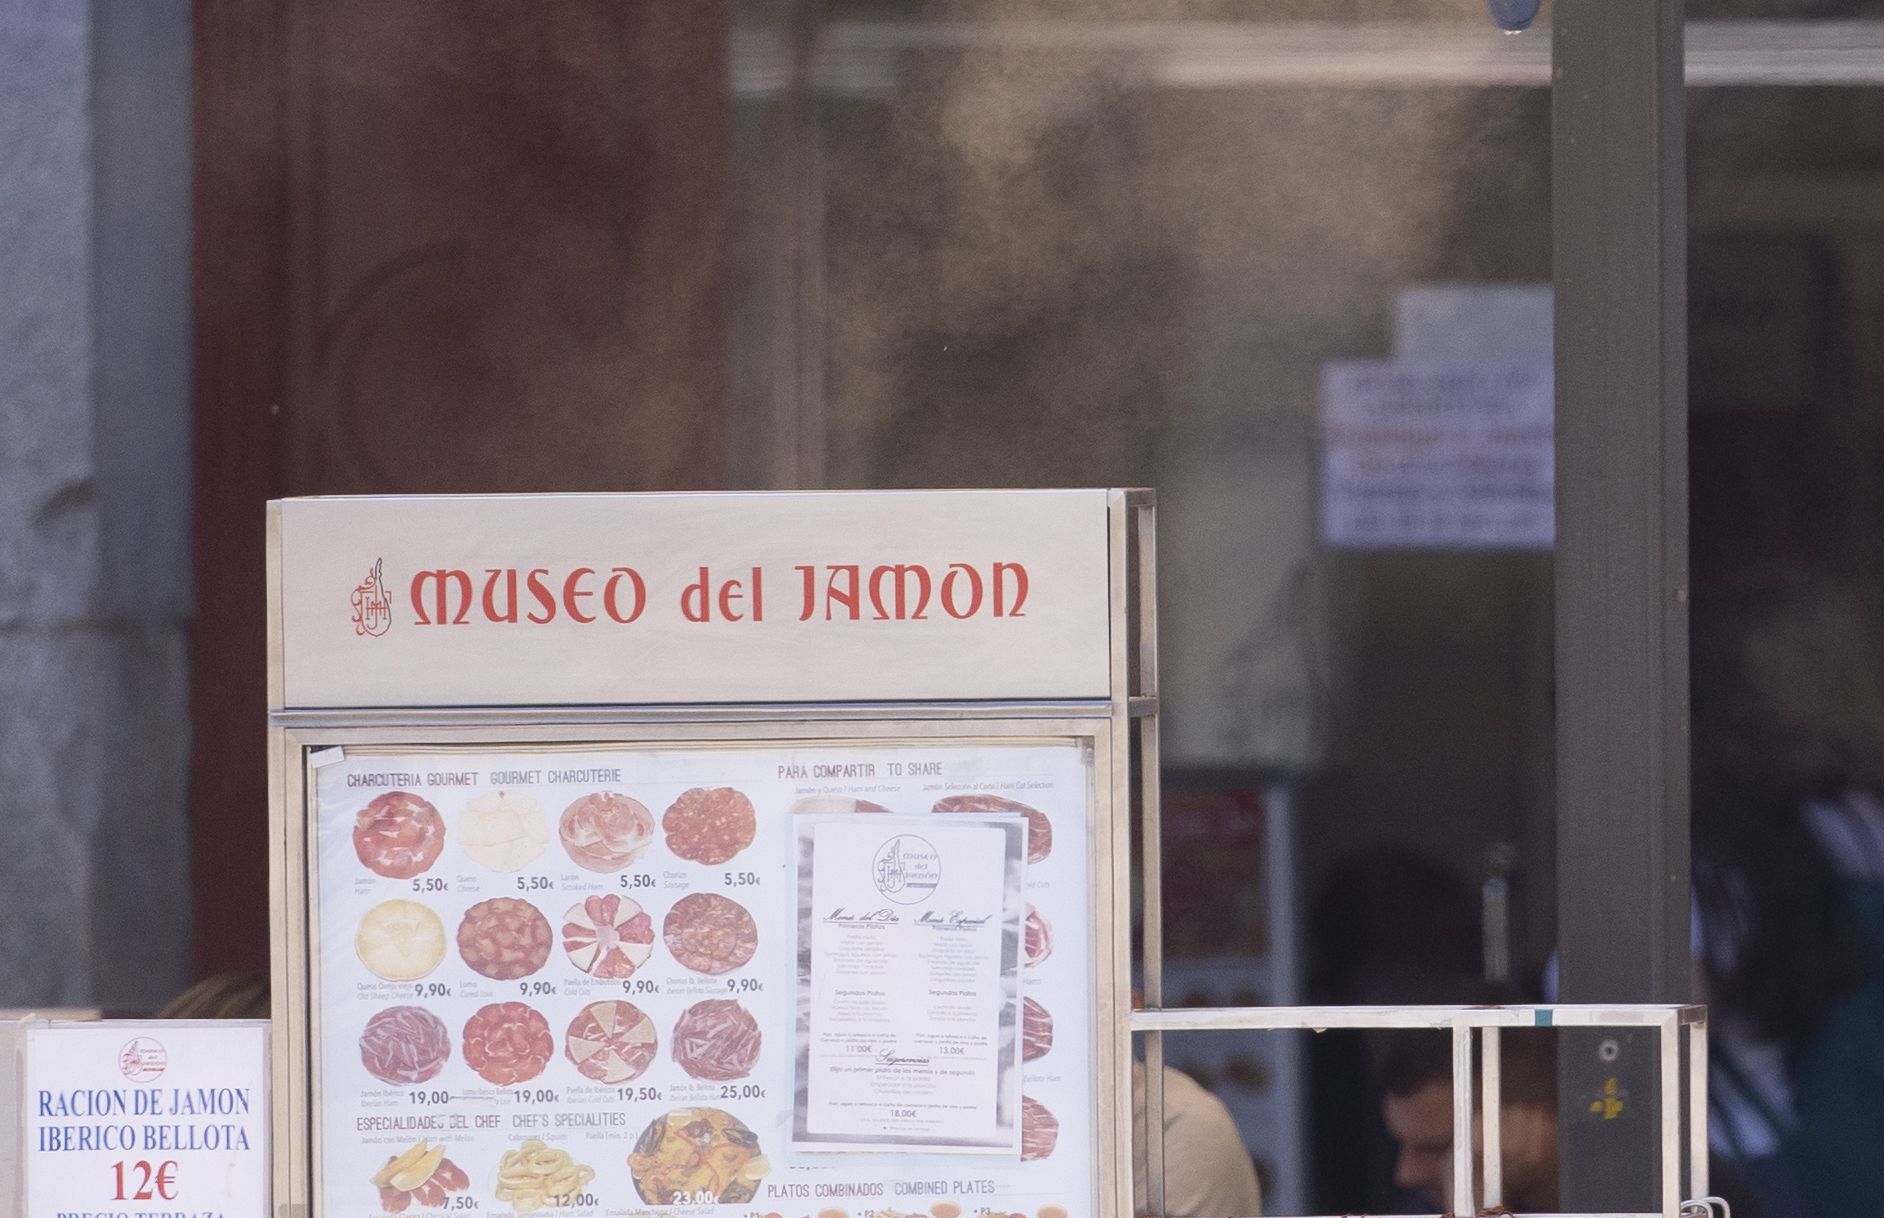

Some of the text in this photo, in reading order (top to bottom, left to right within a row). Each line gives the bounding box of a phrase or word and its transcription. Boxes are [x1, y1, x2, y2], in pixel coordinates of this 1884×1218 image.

[411, 561, 1030, 626] MUSEO del JAMON
[490, 768, 621, 785] GOURMET CHARCUTERIE
[778, 763, 876, 779] PARA COMPARTIR
[888, 762, 943, 776] TO SHARE
[347, 771, 479, 788] CHARCUTERIA GOURMET
[412, 879, 449, 894] 5,50€
[517, 876, 554, 891] 5,50€
[620, 874, 656, 889] 5,50€
[724, 873, 760, 887] 5,50€
[415, 983, 452, 998] 9,90€
[520, 982, 556, 997] 9,90€
[622, 980, 659, 995] 9,90€
[727, 979, 763, 993] 9,90€
[409, 1091, 456, 1106] 19,00
[514, 1090, 559, 1105] 19,00€
[617, 1087, 662, 1103] 19,50€
[720, 1084, 766, 1099] 25,00€
[38, 1087, 250, 1117] RACION DE JAMON
[475, 1114, 501, 1129] CHEF
[513, 1112, 626, 1128] CHEF'S SPECIALITIES
[38, 1124, 250, 1152] IBERICO BELLOTA
[111, 1160, 180, 1201] 12€
[895, 1180, 995, 1196] COMBINED PLATES
[768, 1182, 884, 1198] PLATOS COMBINADOS
[443, 1196, 479, 1211] 7,50€
[553, 1193, 599, 1208] 12,00€
[864, 1209, 874, 1218] P2
[980, 1206, 991, 1216] P3
